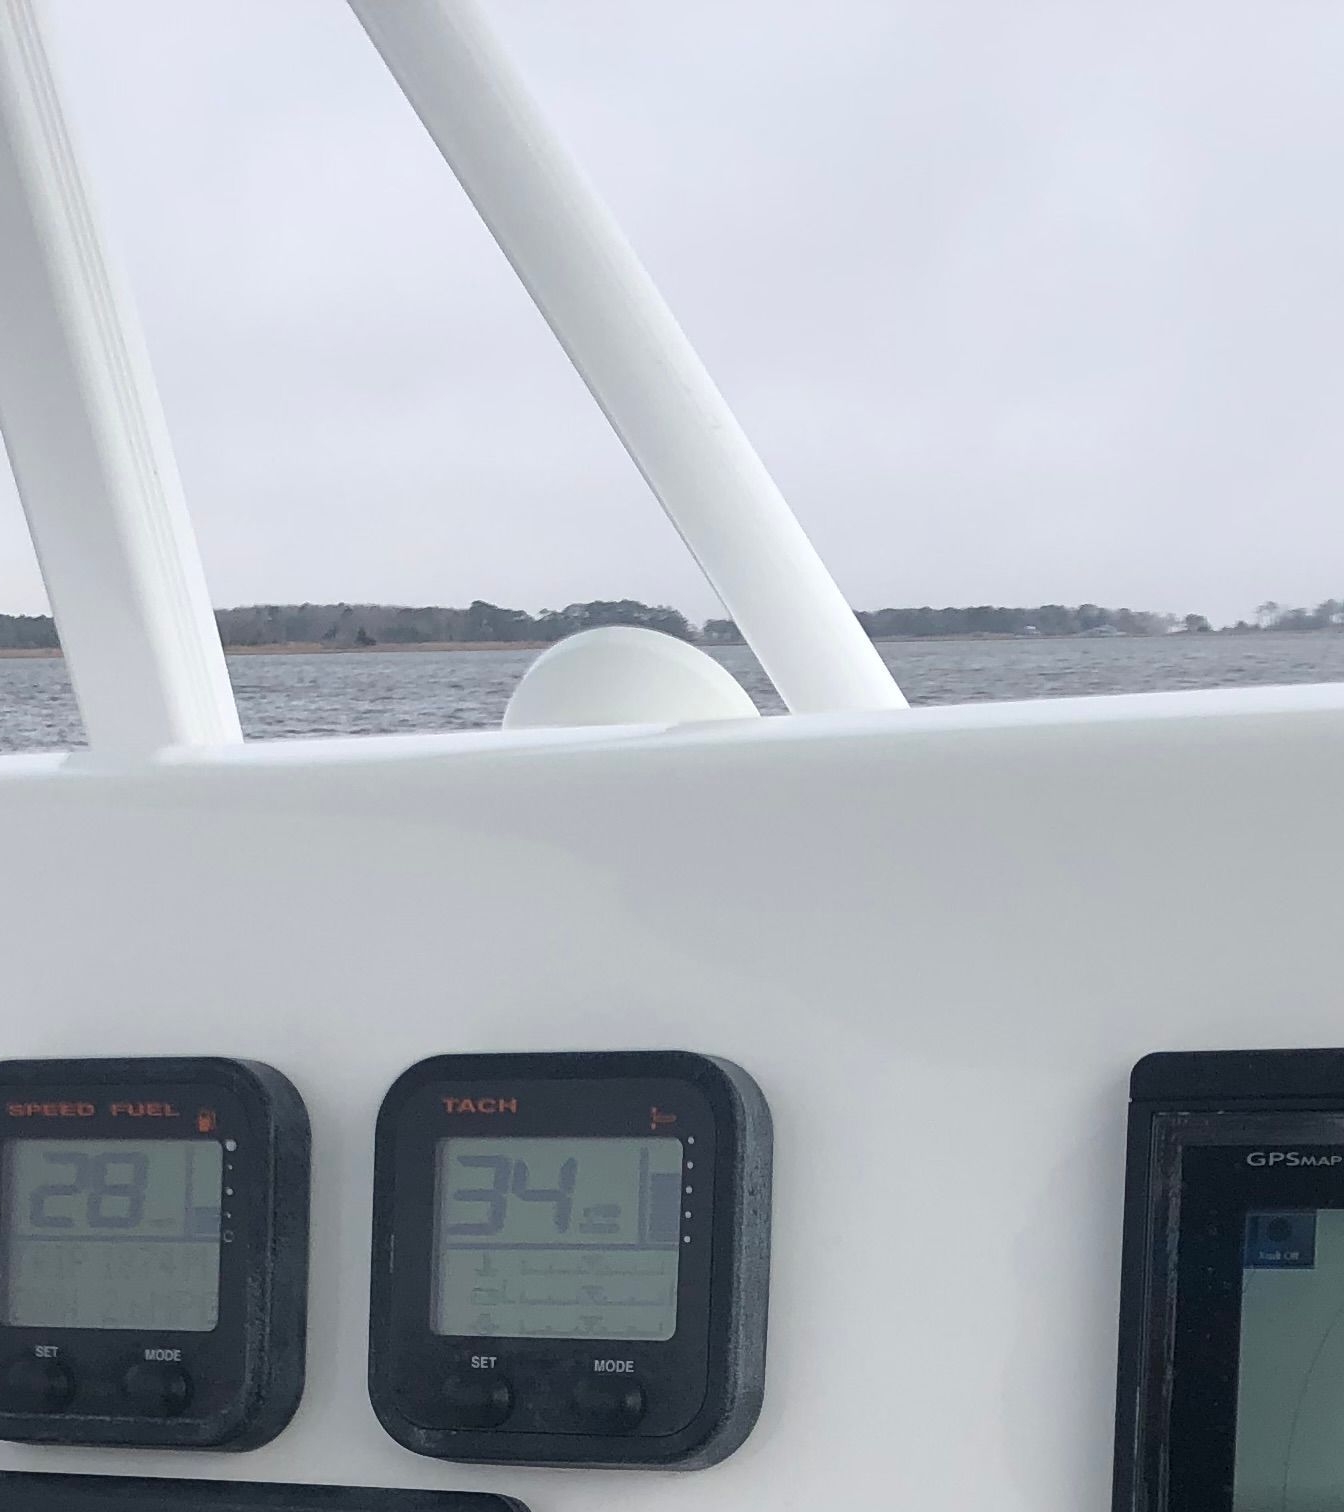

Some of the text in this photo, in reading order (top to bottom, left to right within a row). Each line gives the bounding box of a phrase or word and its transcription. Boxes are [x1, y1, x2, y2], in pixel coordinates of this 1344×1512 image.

[6, 1101, 180, 1117] SPEED FUEL
[442, 1097, 518, 1113] TACH
[1246, 1151, 1343, 1167] GPSMAP
[29, 1151, 149, 1229] 28
[446, 1155, 578, 1235] 34
[35, 1345, 59, 1358] SET
[145, 1348, 182, 1362] MODE
[471, 1356, 497, 1369] SET
[594, 1359, 635, 1373] MODE
